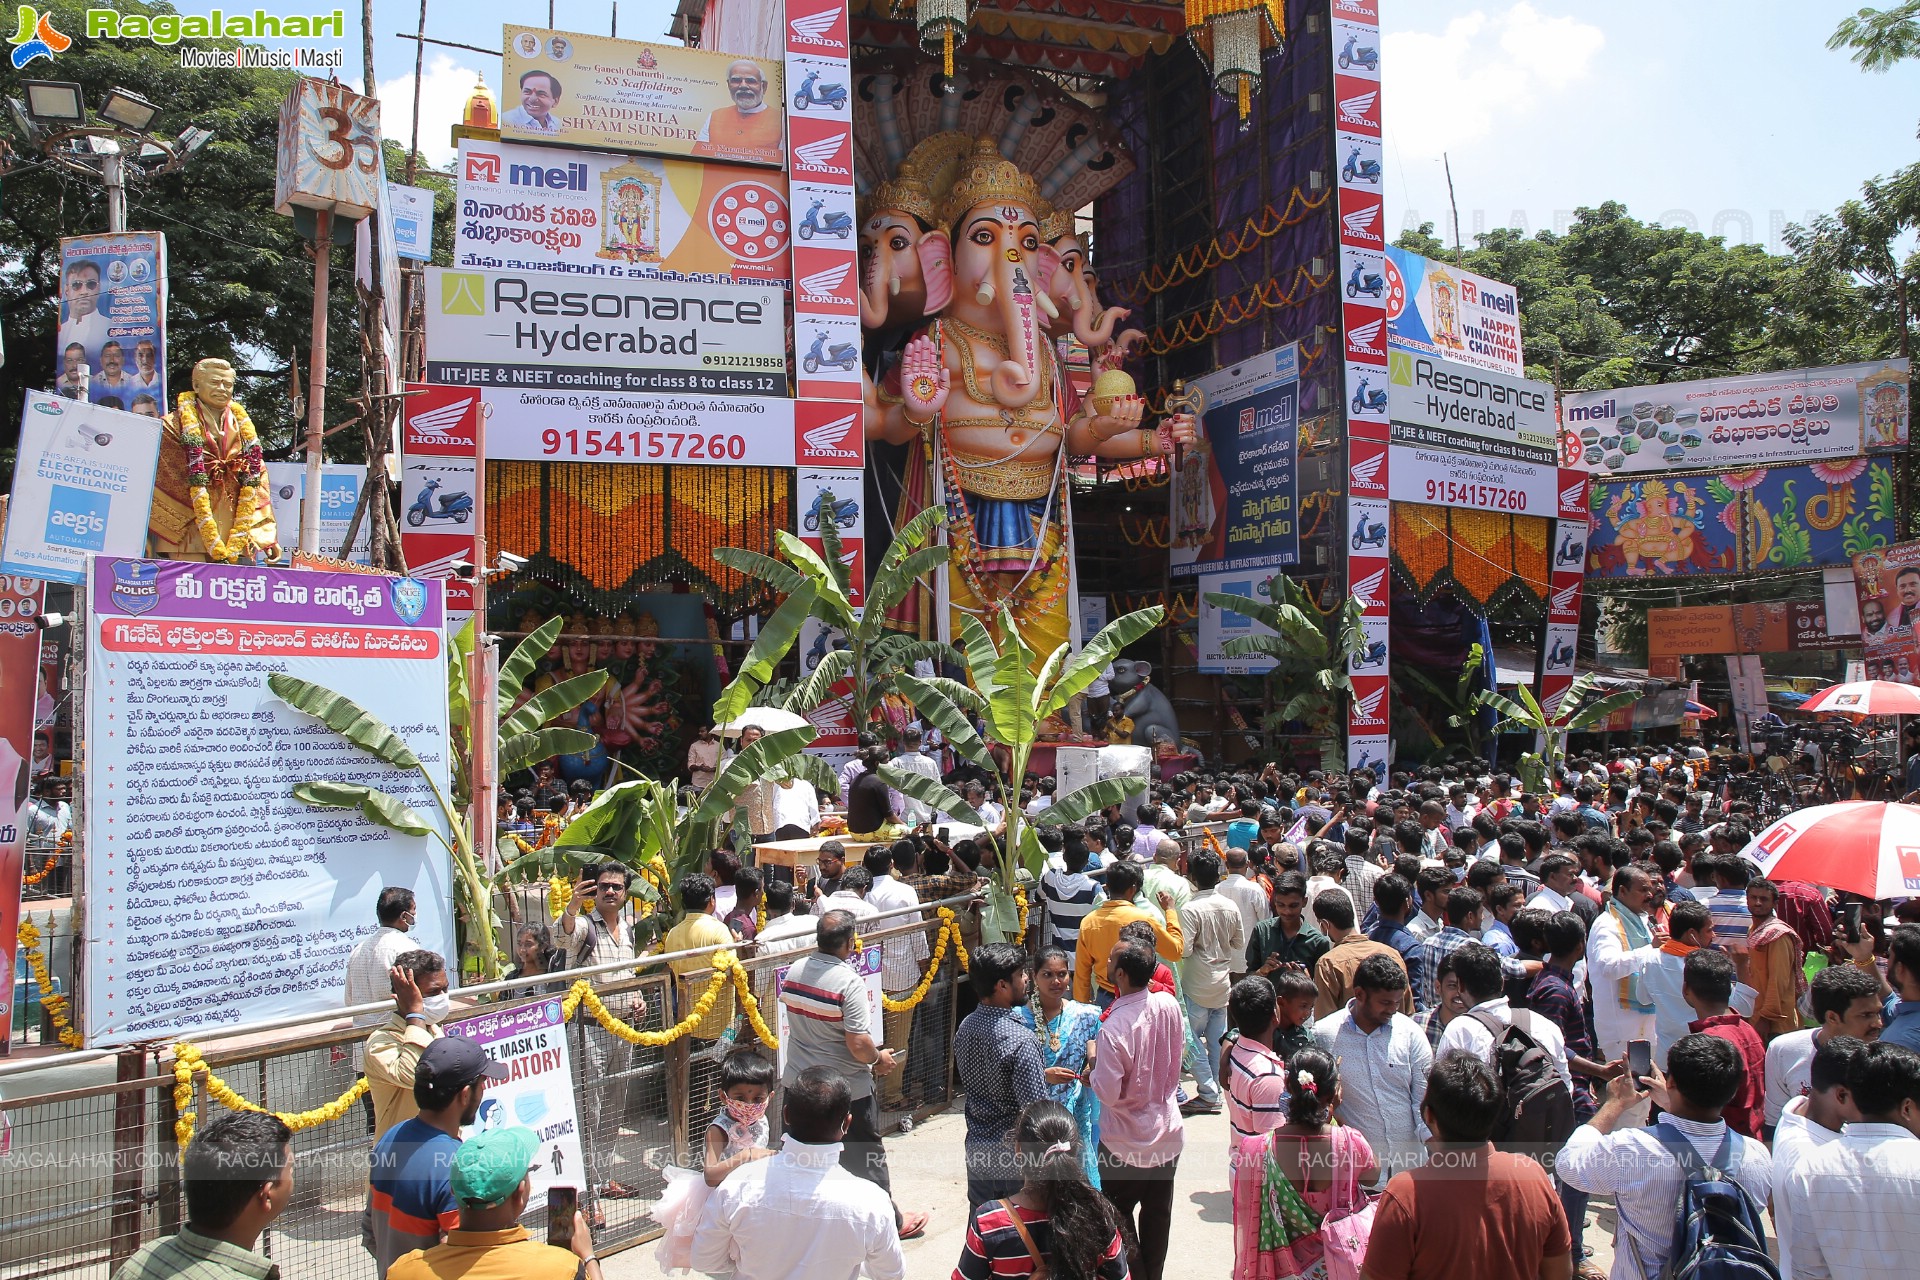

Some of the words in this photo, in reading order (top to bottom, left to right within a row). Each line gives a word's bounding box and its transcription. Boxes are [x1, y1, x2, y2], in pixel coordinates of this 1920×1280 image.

[1335, 3, 1376, 16] HONDA
[790, 35, 845, 49] HONDA
[594, 64, 624, 75] Ganesh
[626, 68, 665, 80] Chaturthi
[604, 76, 619, 86] SS
[621, 78, 684, 94] Scaffoldings
[616, 89, 644, 100] Suppliers
[575, 93, 610, 104] Scaffolding
[583, 104, 679, 125] MADDERLA
[1340, 114, 1379, 128] HONDA
[562, 116, 623, 134] SHYAM
[628, 123, 697, 141] SUNDER
[603, 137, 633, 146] Managing
[510, 162, 588, 192] meil
[794, 163, 849, 176] HONDA
[463, 199, 546, 223] వినాయక
[550, 206, 597, 228] చవితి
[747, 217, 765, 227] meil
[462, 220, 582, 255] శుభాకాంక్షలు
[1344, 229, 1381, 242] HONDA
[730, 262, 774, 273] www.meil.in
[800, 295, 855, 306] HONDA
[1480, 289, 1515, 316] meil
[1481, 316, 1516, 336] HAPPY
[515, 322, 698, 357] Hyderabad
[1463, 324, 1517, 351] VINAYAKA
[1349, 345, 1385, 356] HONDA
[1393, 334, 1436, 355] ENGINEERING
[1443, 348, 1502, 373] INFRASTRUCTURES
[1503, 364, 1517, 376] LTD.
[1468, 340, 1518, 364] CHAVITHI
[714, 354, 784, 368] 9121219858
[441, 367, 491, 384] IIT-JEE
[495, 369, 508, 384] &
[512, 369, 553, 384] NEET
[557, 369, 623, 389] coaching
[625, 372, 647, 387] for
[650, 373, 685, 388] class
[688, 375, 698, 388] 8
[701, 376, 716, 389] to
[719, 375, 753, 390] class
[756, 377, 774, 390] 12
[36, 404, 61, 415] GHMC
[668, 400, 705, 411] మరింత
[708, 401, 765, 414] సమాచారం
[1256, 395, 1291, 429] meil
[1427, 394, 1515, 432] Hyderabad
[1569, 400, 1616, 422] meil
[1700, 397, 1782, 423] వినాయక
[1788, 394, 1839, 415] చవితి
[588, 413, 624, 424] కొరకు
[409, 435, 474, 447] HONDA
[1707, 418, 1831, 446] శుభాకాంక్షలు
[541, 428, 746, 460] 9154157260
[1391, 424, 1416, 439] IIT-JEE
[1418, 428, 1425, 440] &
[1426, 430, 1447, 444] NEET
[1448, 434, 1480, 453] coaching
[1481, 440, 1492, 452] for
[1493, 443, 1510, 456] class
[1511, 446, 1517, 456] 8
[1518, 448, 1525, 458] to
[1526, 449, 1542, 461] class
[1543, 452, 1552, 462] 12
[42, 451, 62, 461] THIS
[64, 455, 86, 465] AREA
[100, 461, 129, 472] UNDER
[803, 448, 858, 459] HONDA
[1687, 456, 1712, 464] Megha
[1712, 452, 1757, 462] Engineering
[1766, 448, 1823, 458] Infrastructures
[1824, 445, 1854, 453] Limited
[39, 458, 128, 483] ELECTRONIC
[37, 470, 127, 493] SURVEILLANCE
[1351, 481, 1385, 490] HONDA
[1426, 479, 1527, 510] 9154157260
[1242, 495, 1290, 520] స్వాగతం
[1560, 505, 1587, 514] HONDA
[51, 510, 104, 535] aegis
[1229, 519, 1291, 544] సుస్వాగతం
[49, 533, 101, 547] AUTOMATION
[14, 549, 35, 559] Aegis
[37, 552, 79, 565] Automation
[1191, 562, 1224, 574] ENGINEERING
[1230, 554, 1282, 569] INFRASTRUCTURES
[116, 584, 156, 596] POLICE
[176, 573, 202, 598] మీ
[210, 576, 267, 609] రక్షణే
[273, 581, 307, 604] మా
[314, 585, 381, 616] బాధ్యత
[1551, 608, 1577, 616] HONDA
[115, 623, 163, 646] గణేష్
[167, 626, 234, 650] భక్తులకు
[238, 629, 306, 651] సైఫాబాద్
[311, 631, 360, 649] పోలీసు
[364, 632, 428, 652] సూచనలు
[127, 660, 149, 674] దర్శన
[152, 660, 198, 671] సమయంలో
[127, 677, 146, 690] చిన్న
[500, 1038, 533, 1058] MASK
[535, 1034, 548, 1049] IS
[545, 1119, 573, 1141] DISTANCE
